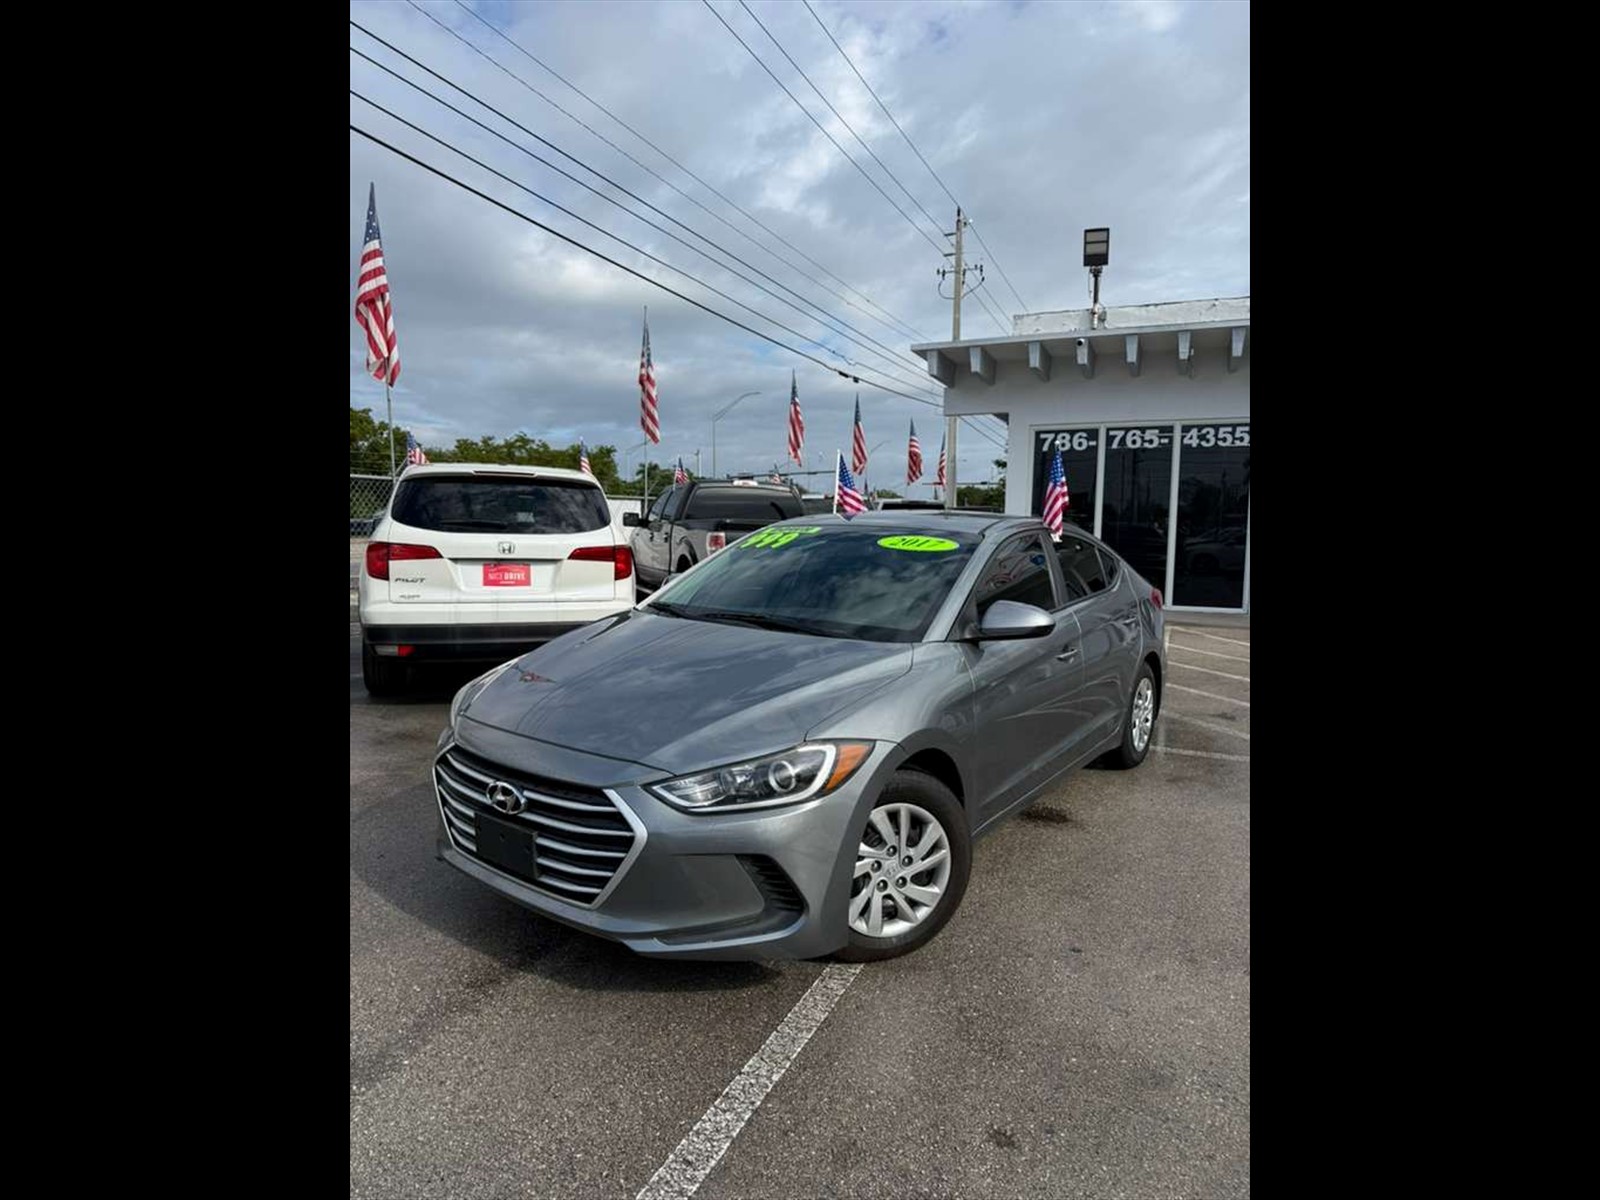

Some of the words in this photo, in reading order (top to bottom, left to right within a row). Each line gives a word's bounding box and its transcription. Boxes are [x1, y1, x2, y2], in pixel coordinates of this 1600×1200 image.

[1039, 432, 1096, 452] 786-
[1108, 429, 1169, 449] 765-
[1183, 426, 1250, 447] 4355
[887, 538, 947, 548] 2017
